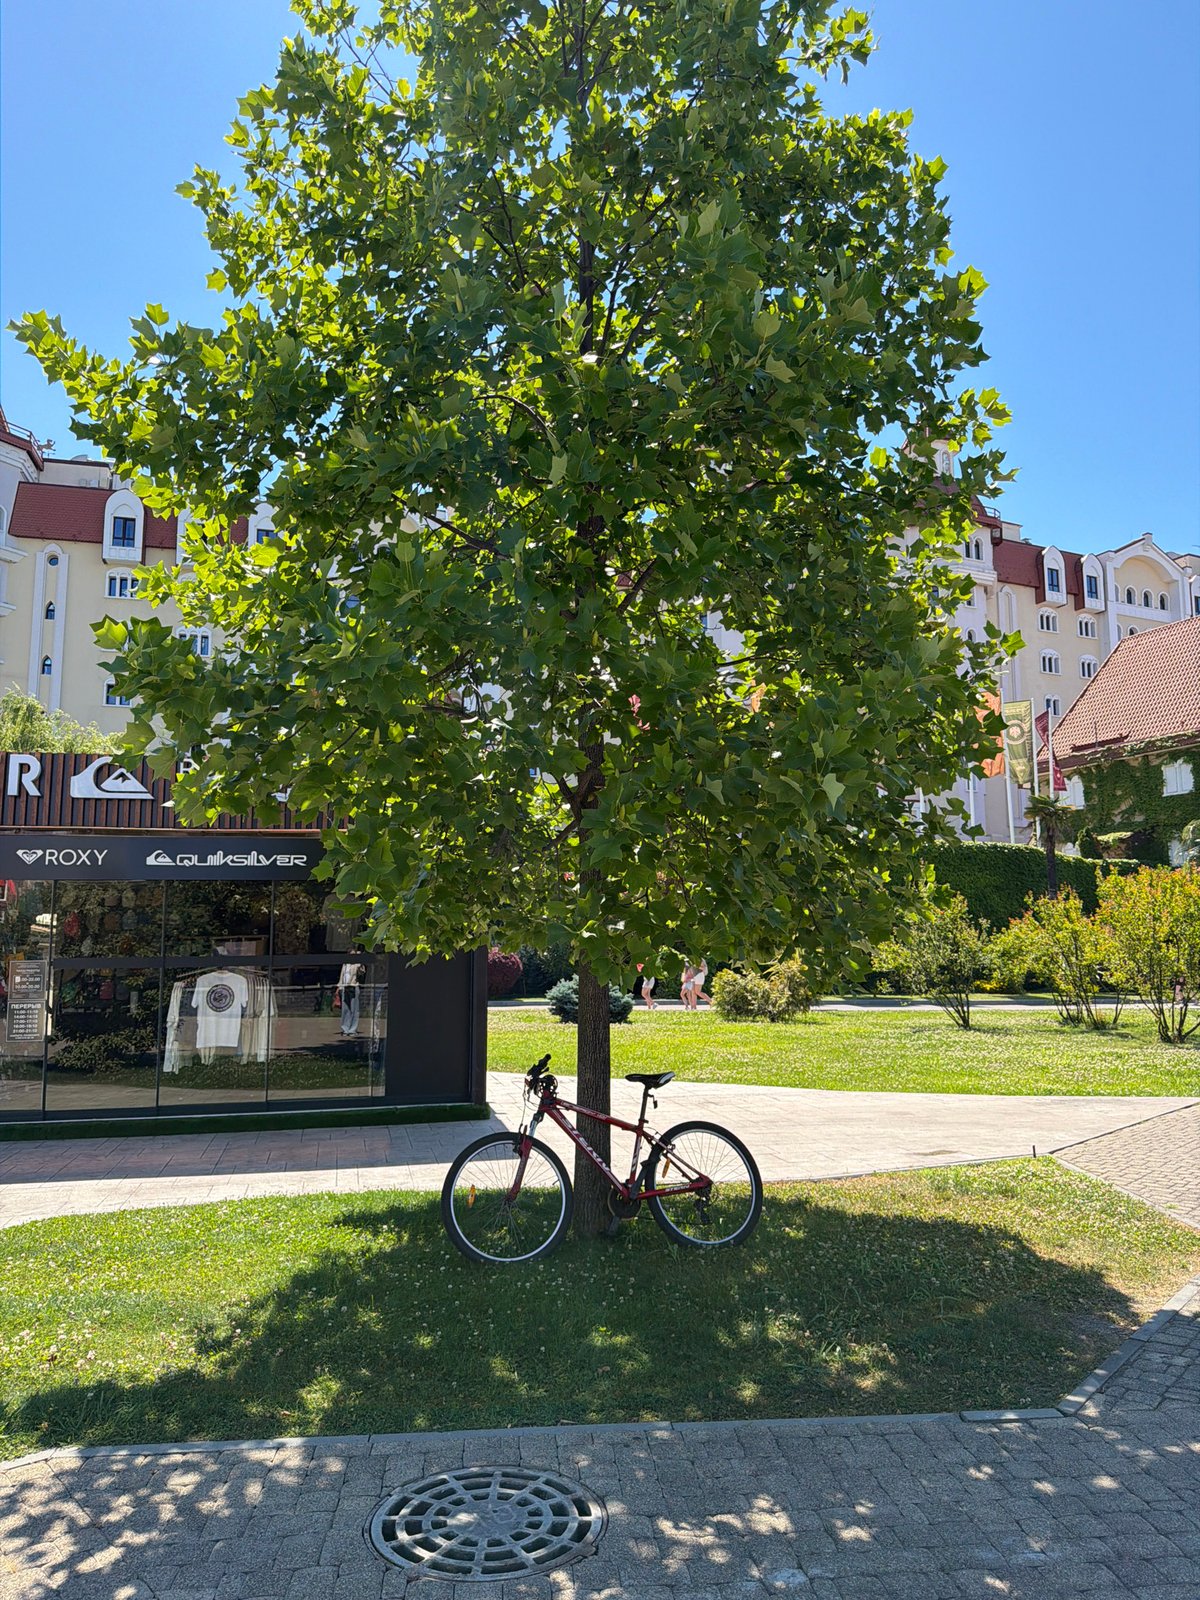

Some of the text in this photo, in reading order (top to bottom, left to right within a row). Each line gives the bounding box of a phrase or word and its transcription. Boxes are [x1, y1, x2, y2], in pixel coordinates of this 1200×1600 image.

[45, 849, 108, 866] ROXY
[176, 850, 307, 867] QUIKSILVER
[561, 1117, 610, 1171] STERN
